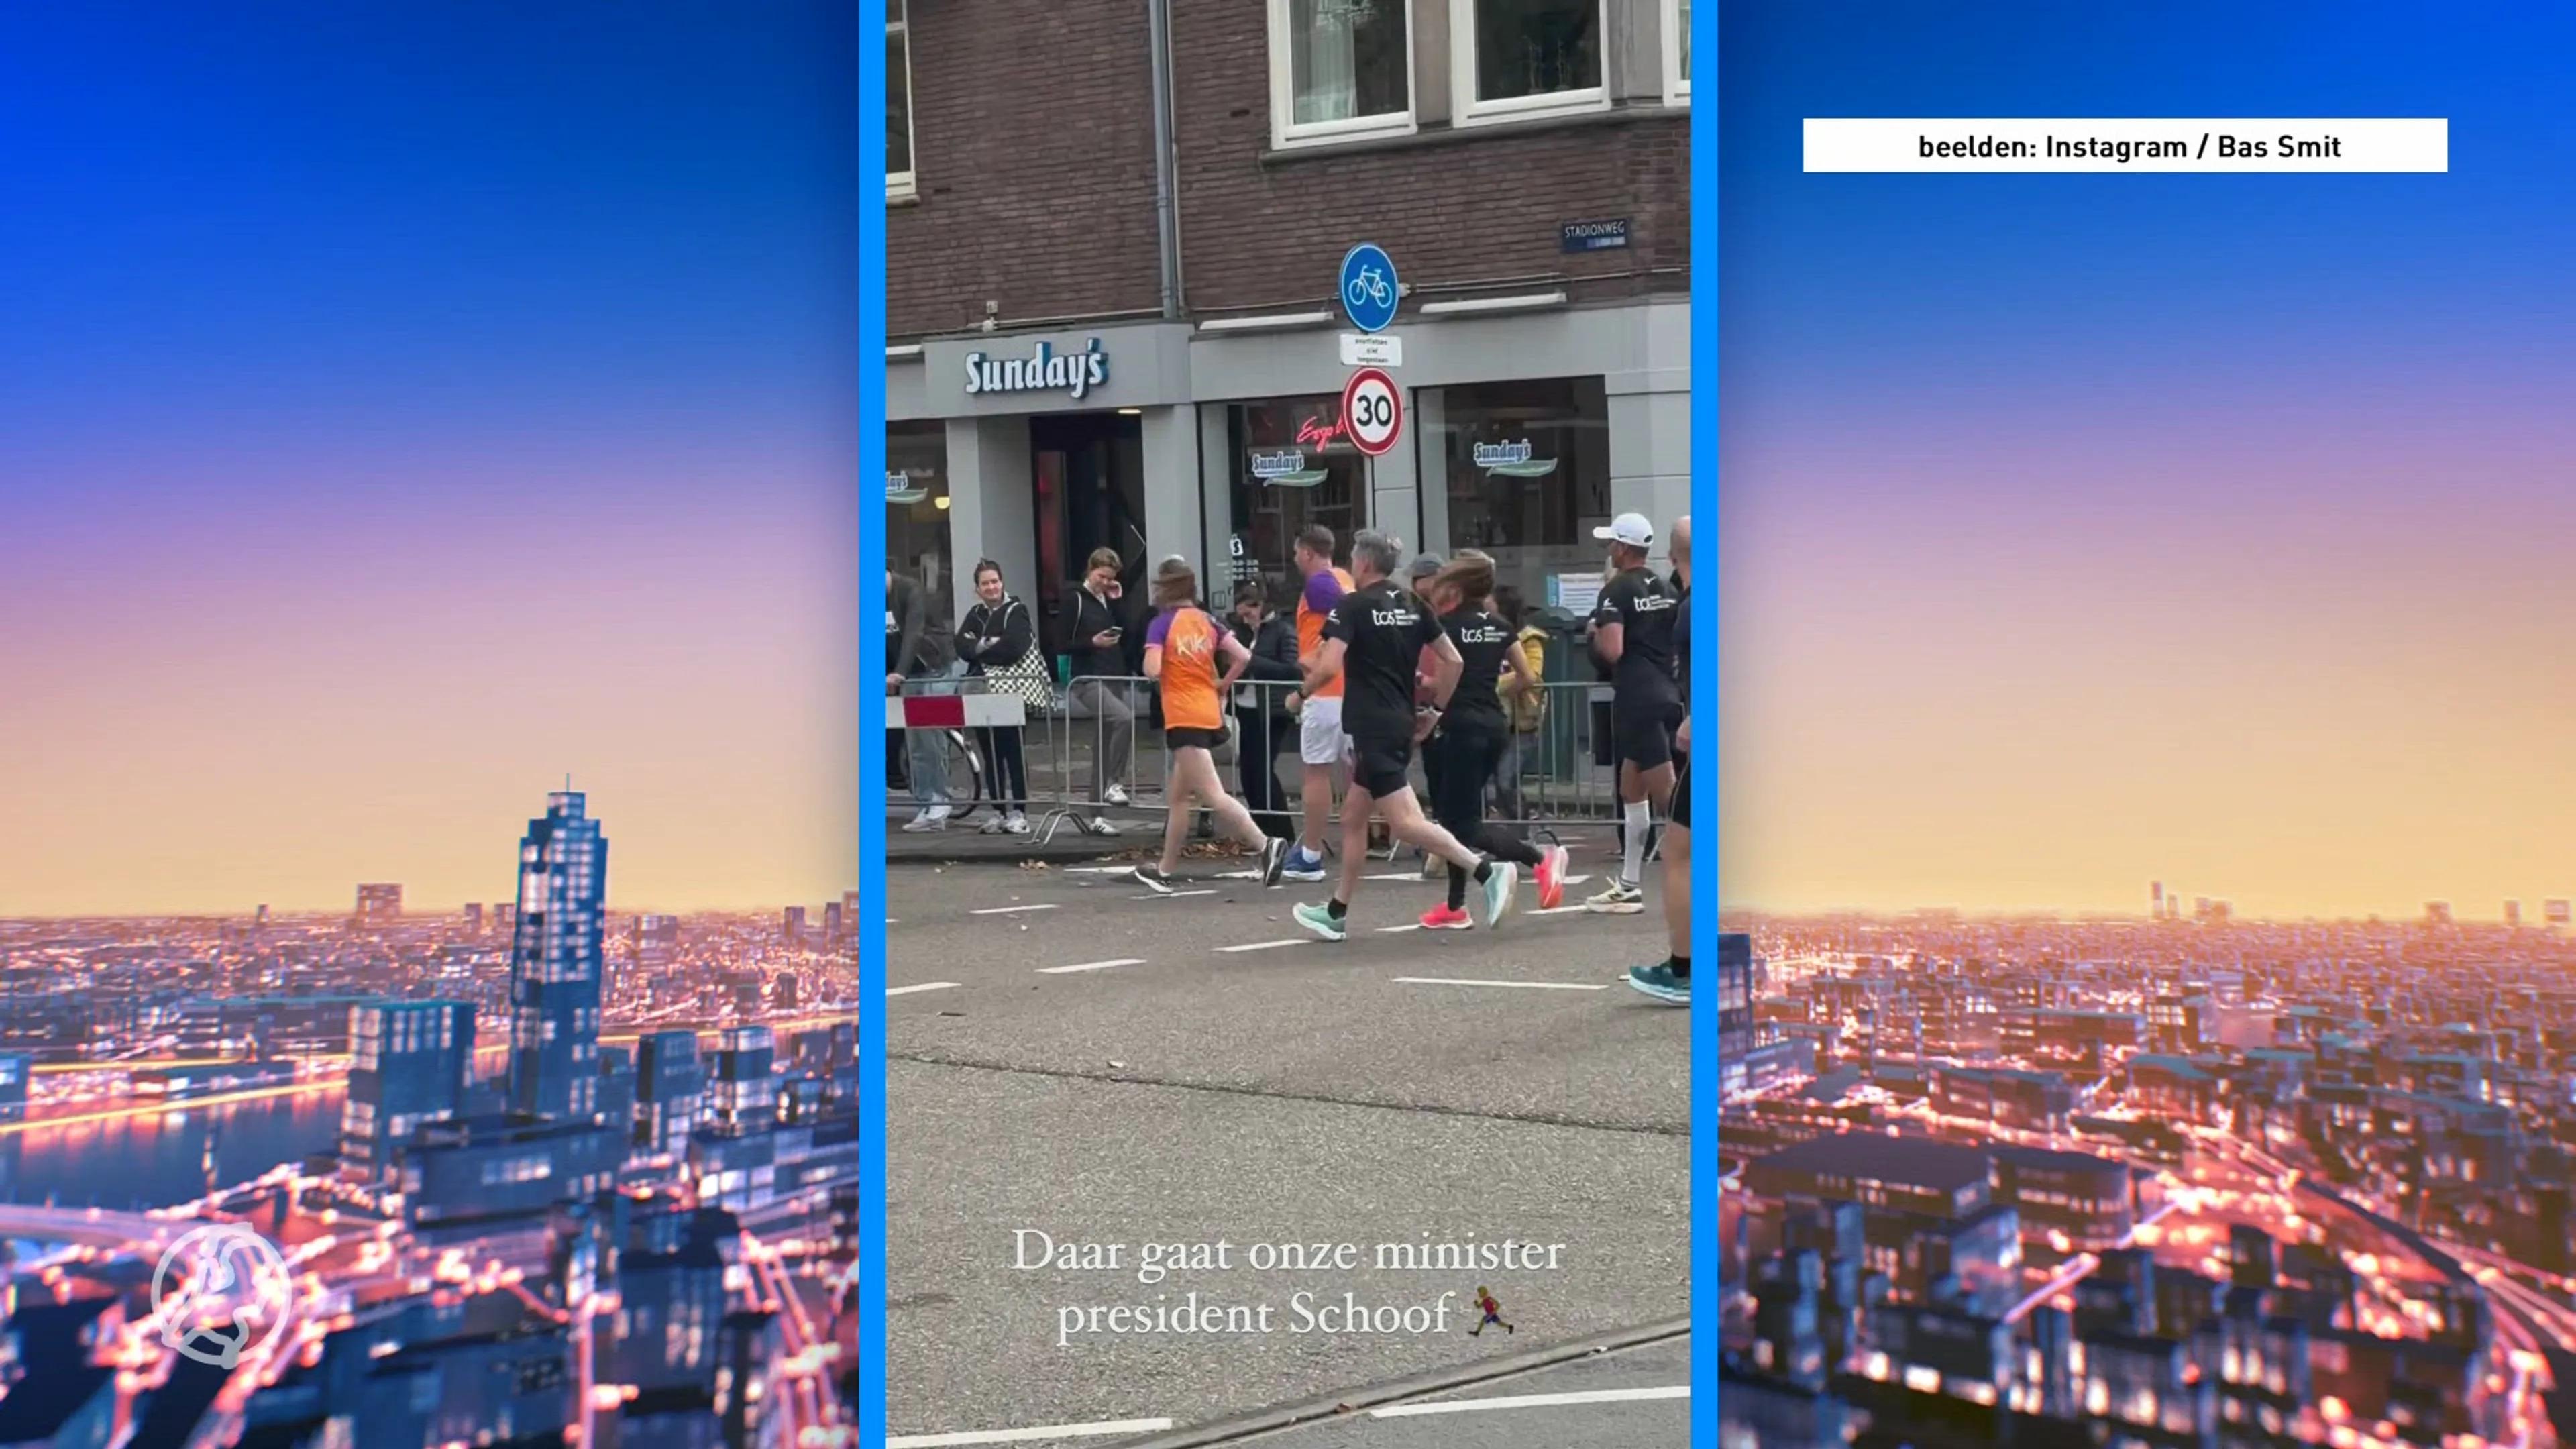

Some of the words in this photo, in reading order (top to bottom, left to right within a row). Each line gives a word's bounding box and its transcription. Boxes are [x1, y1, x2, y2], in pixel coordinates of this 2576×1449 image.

[1564, 221, 1625, 238] STADIONWEG
[965, 337, 1108, 400] Sunday's
[1356, 394, 1393, 427] 30
[1252, 449, 1305, 473] Sunday's
[1474, 439, 1531, 464] Sunday's
